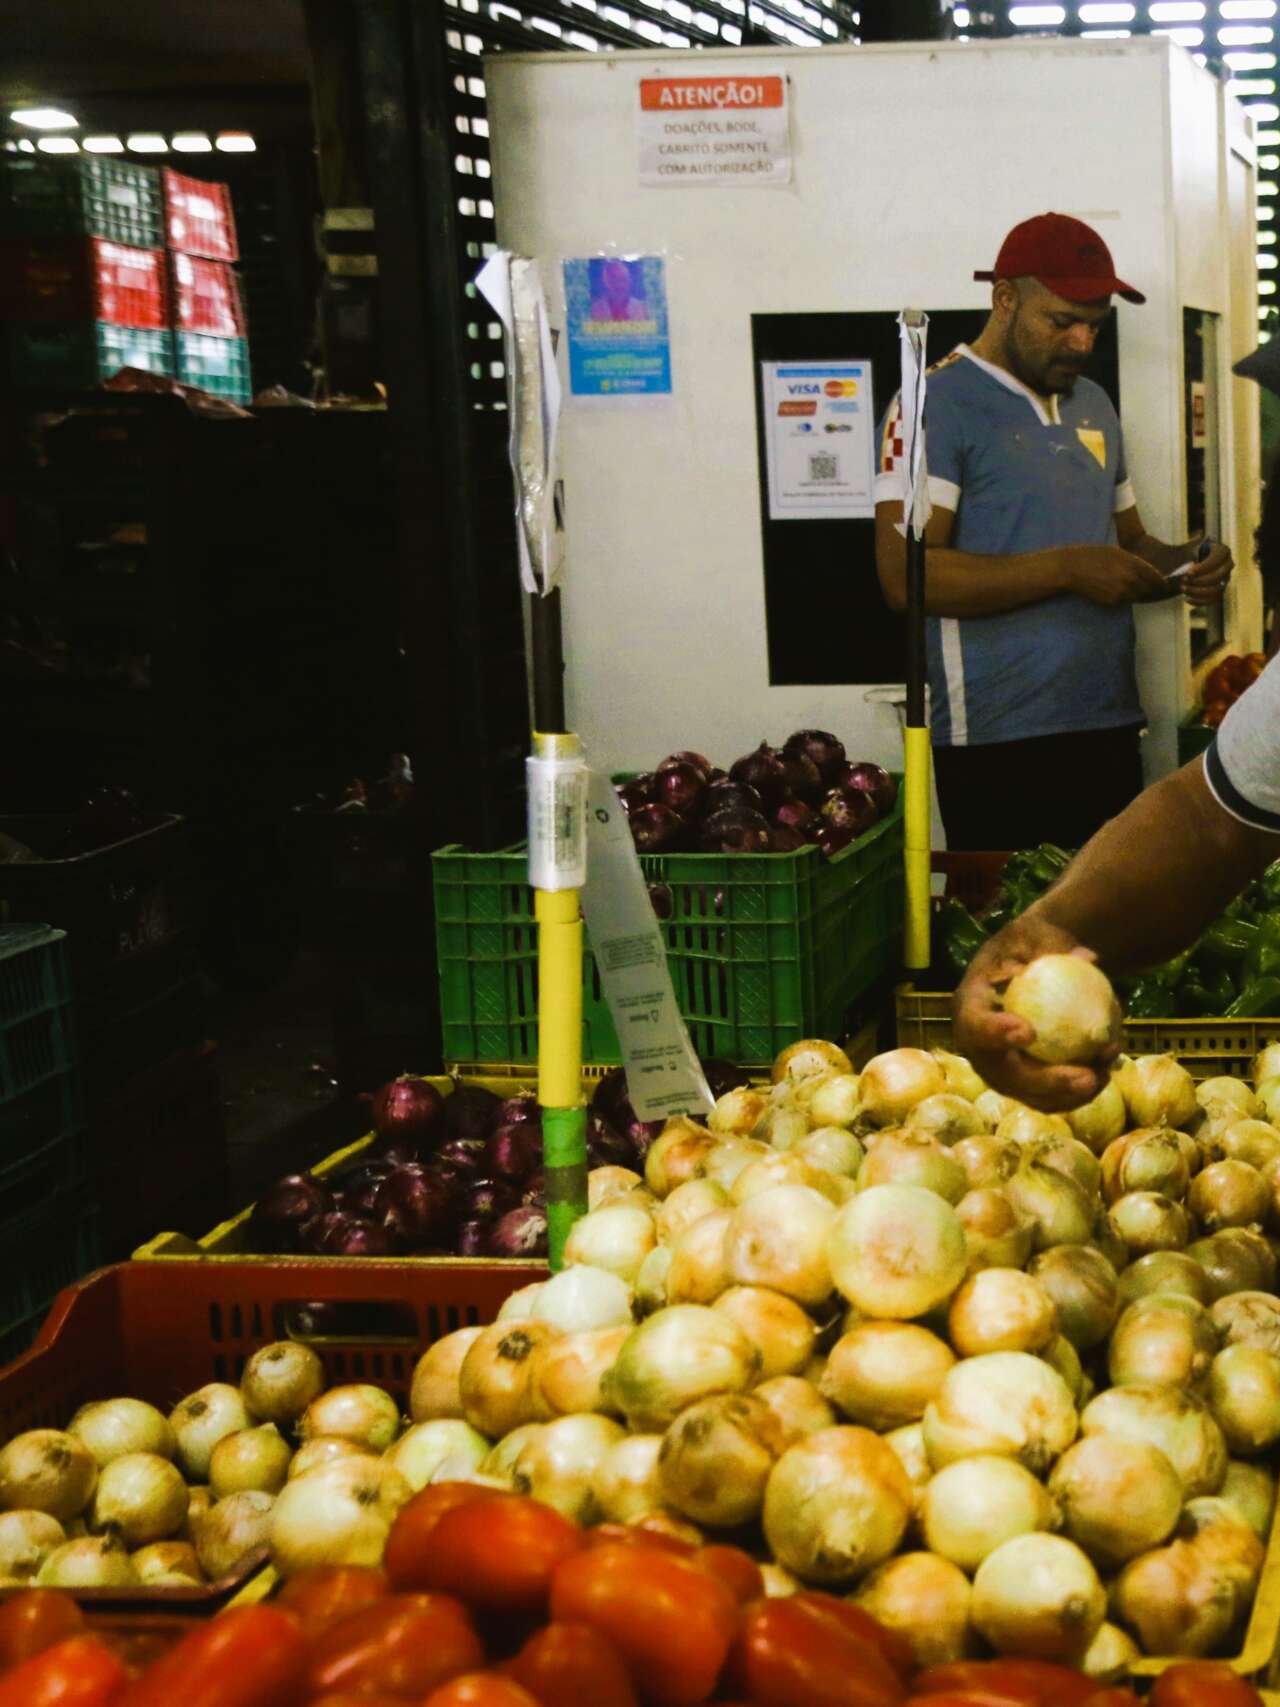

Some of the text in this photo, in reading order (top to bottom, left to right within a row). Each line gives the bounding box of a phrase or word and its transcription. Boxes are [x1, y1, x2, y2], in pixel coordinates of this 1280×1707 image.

[660, 82, 763, 108] ATENÇÃO!
[713, 141, 769, 154] SOMENTE
[657, 164, 687, 176] COM
[788, 384, 821, 394] VISA
